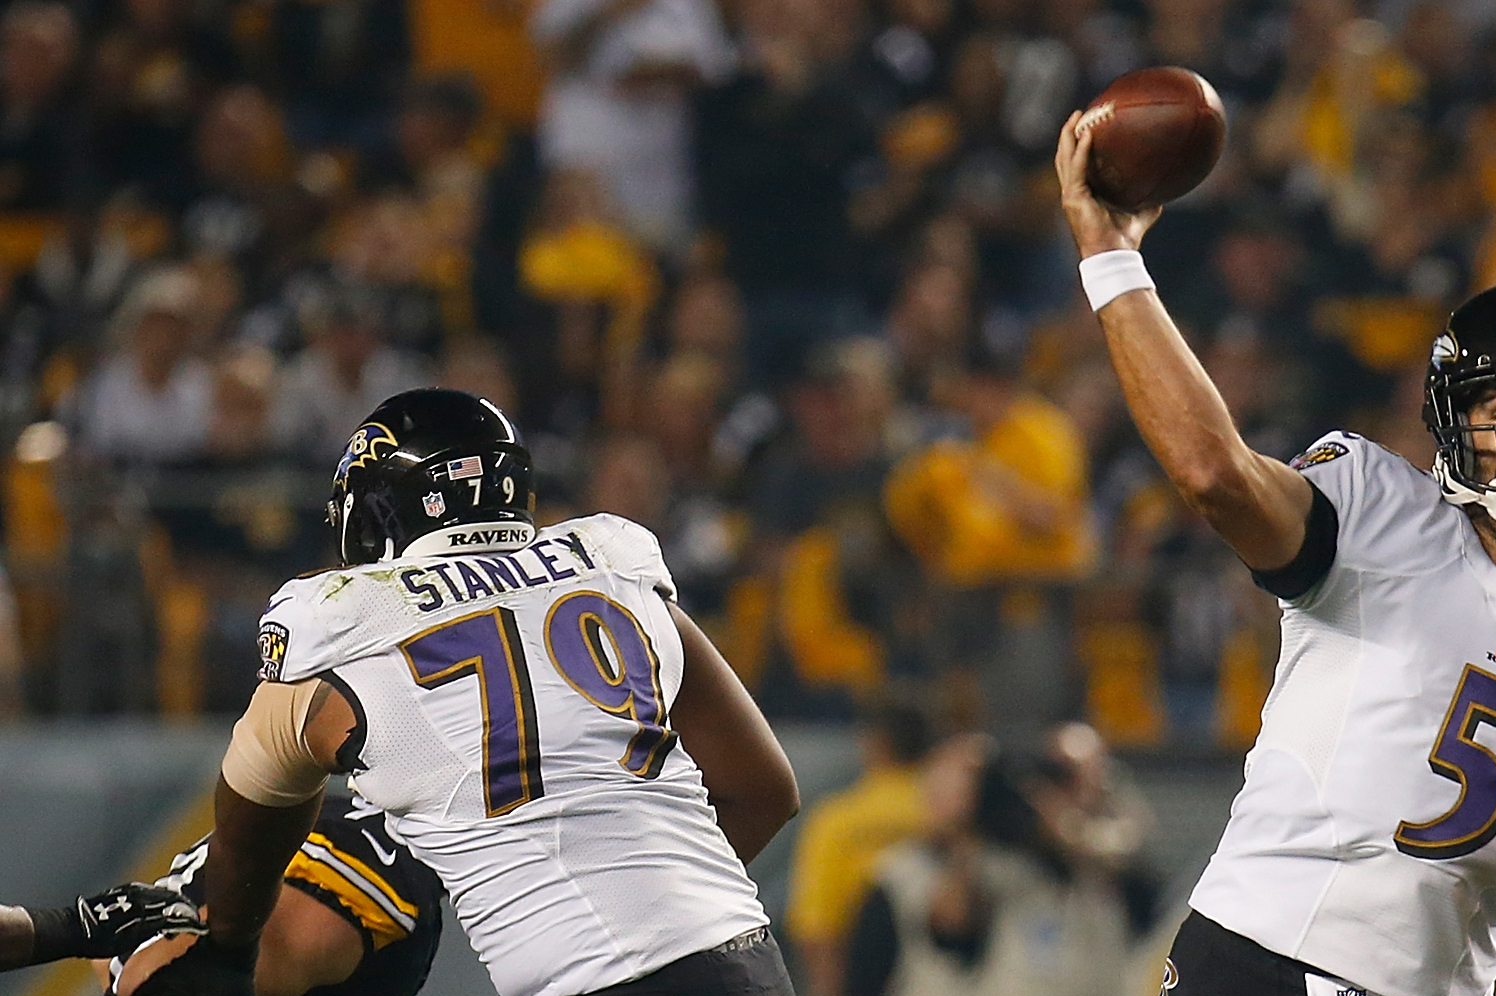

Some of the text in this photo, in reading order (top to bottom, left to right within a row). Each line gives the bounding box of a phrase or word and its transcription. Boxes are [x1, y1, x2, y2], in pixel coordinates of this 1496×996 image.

[468, 476, 515, 506] 7 9
[448, 529, 529, 547] RAVENS
[401, 532, 596, 612] STANLEY
[396, 590, 679, 819] 79
